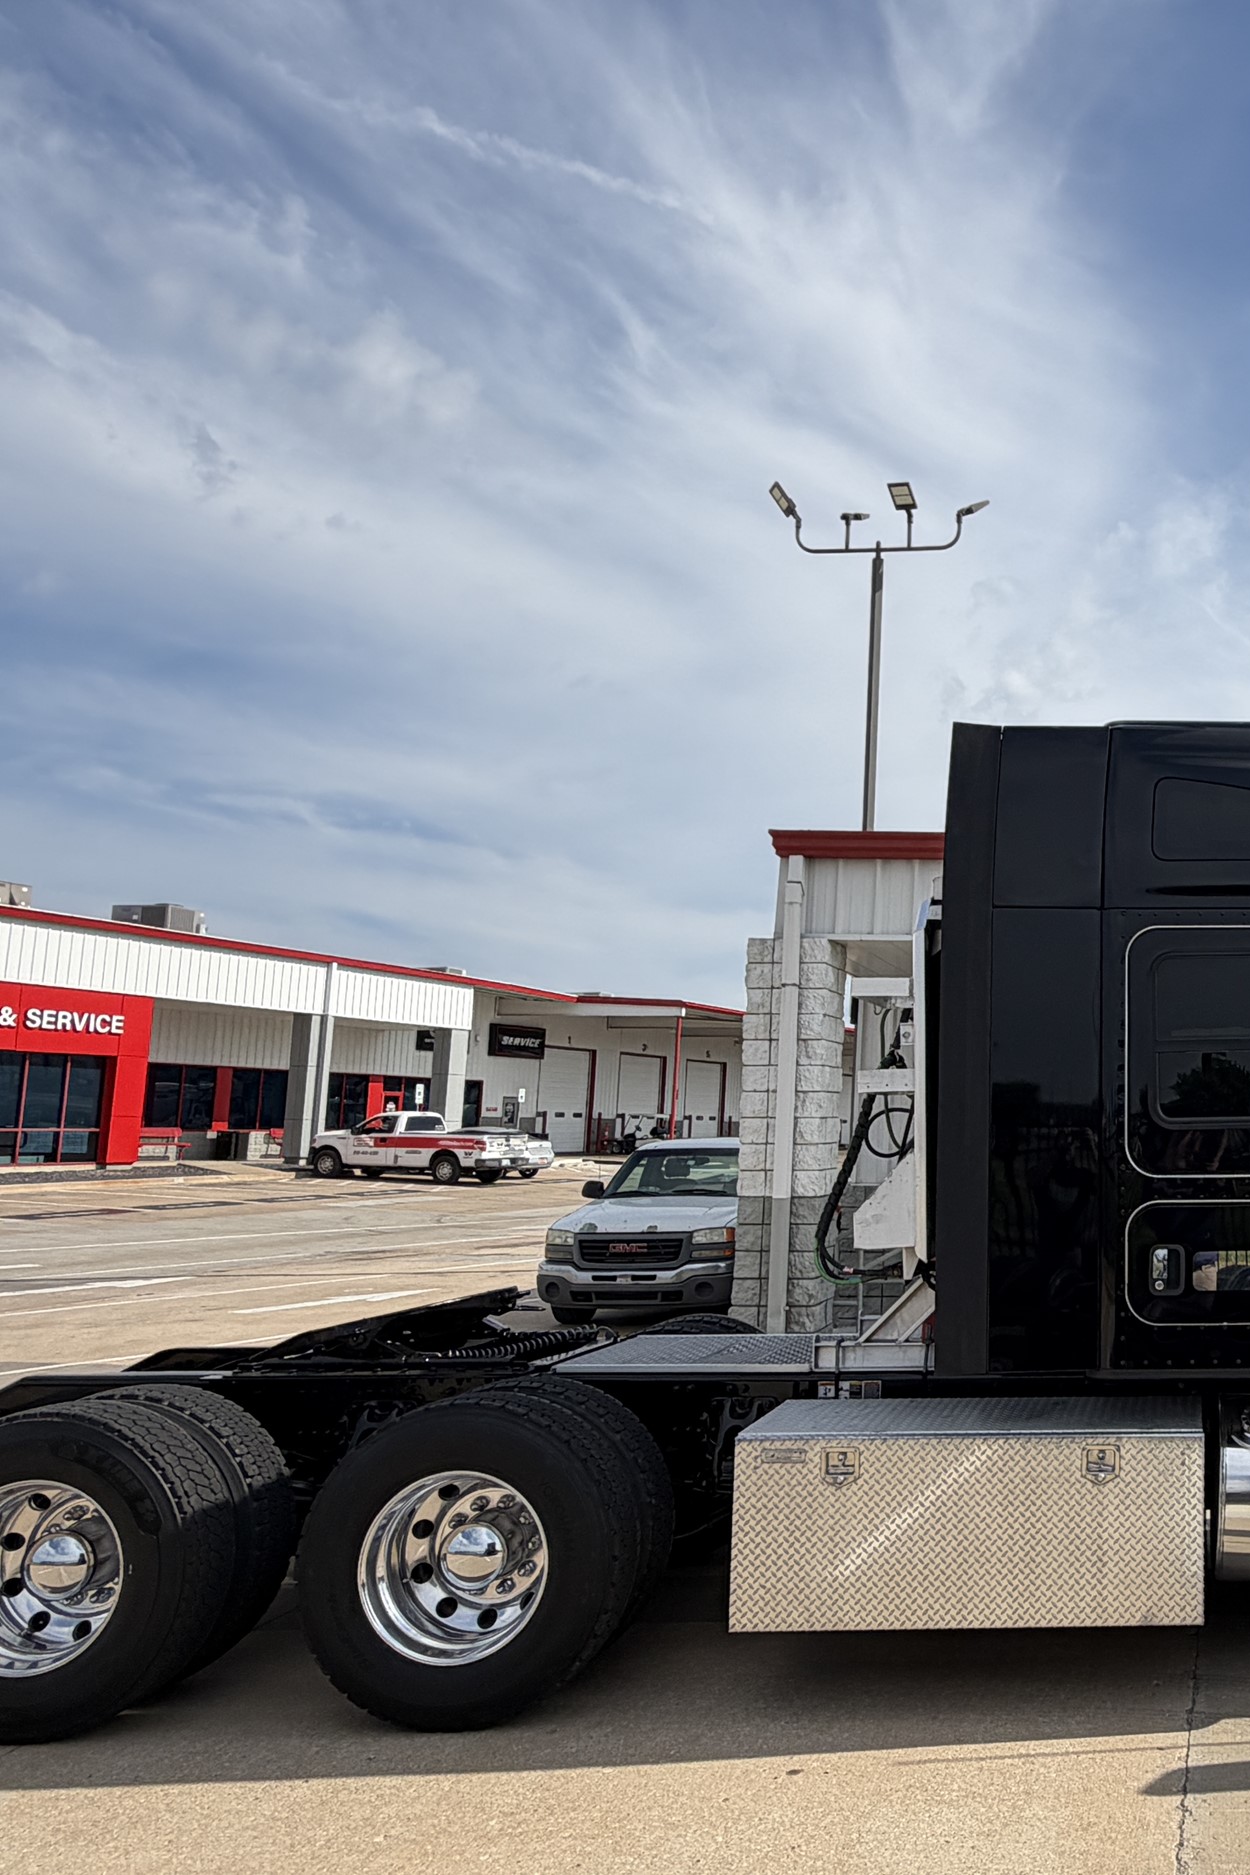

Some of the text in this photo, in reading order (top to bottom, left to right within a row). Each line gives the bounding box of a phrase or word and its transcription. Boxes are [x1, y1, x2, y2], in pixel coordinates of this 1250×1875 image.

[0, 1006, 125, 1034] & SERVICE
[501, 1035, 542, 1048] SERVICE
[567, 1035, 572, 1045] 1
[609, 1242, 648, 1253] GMC
